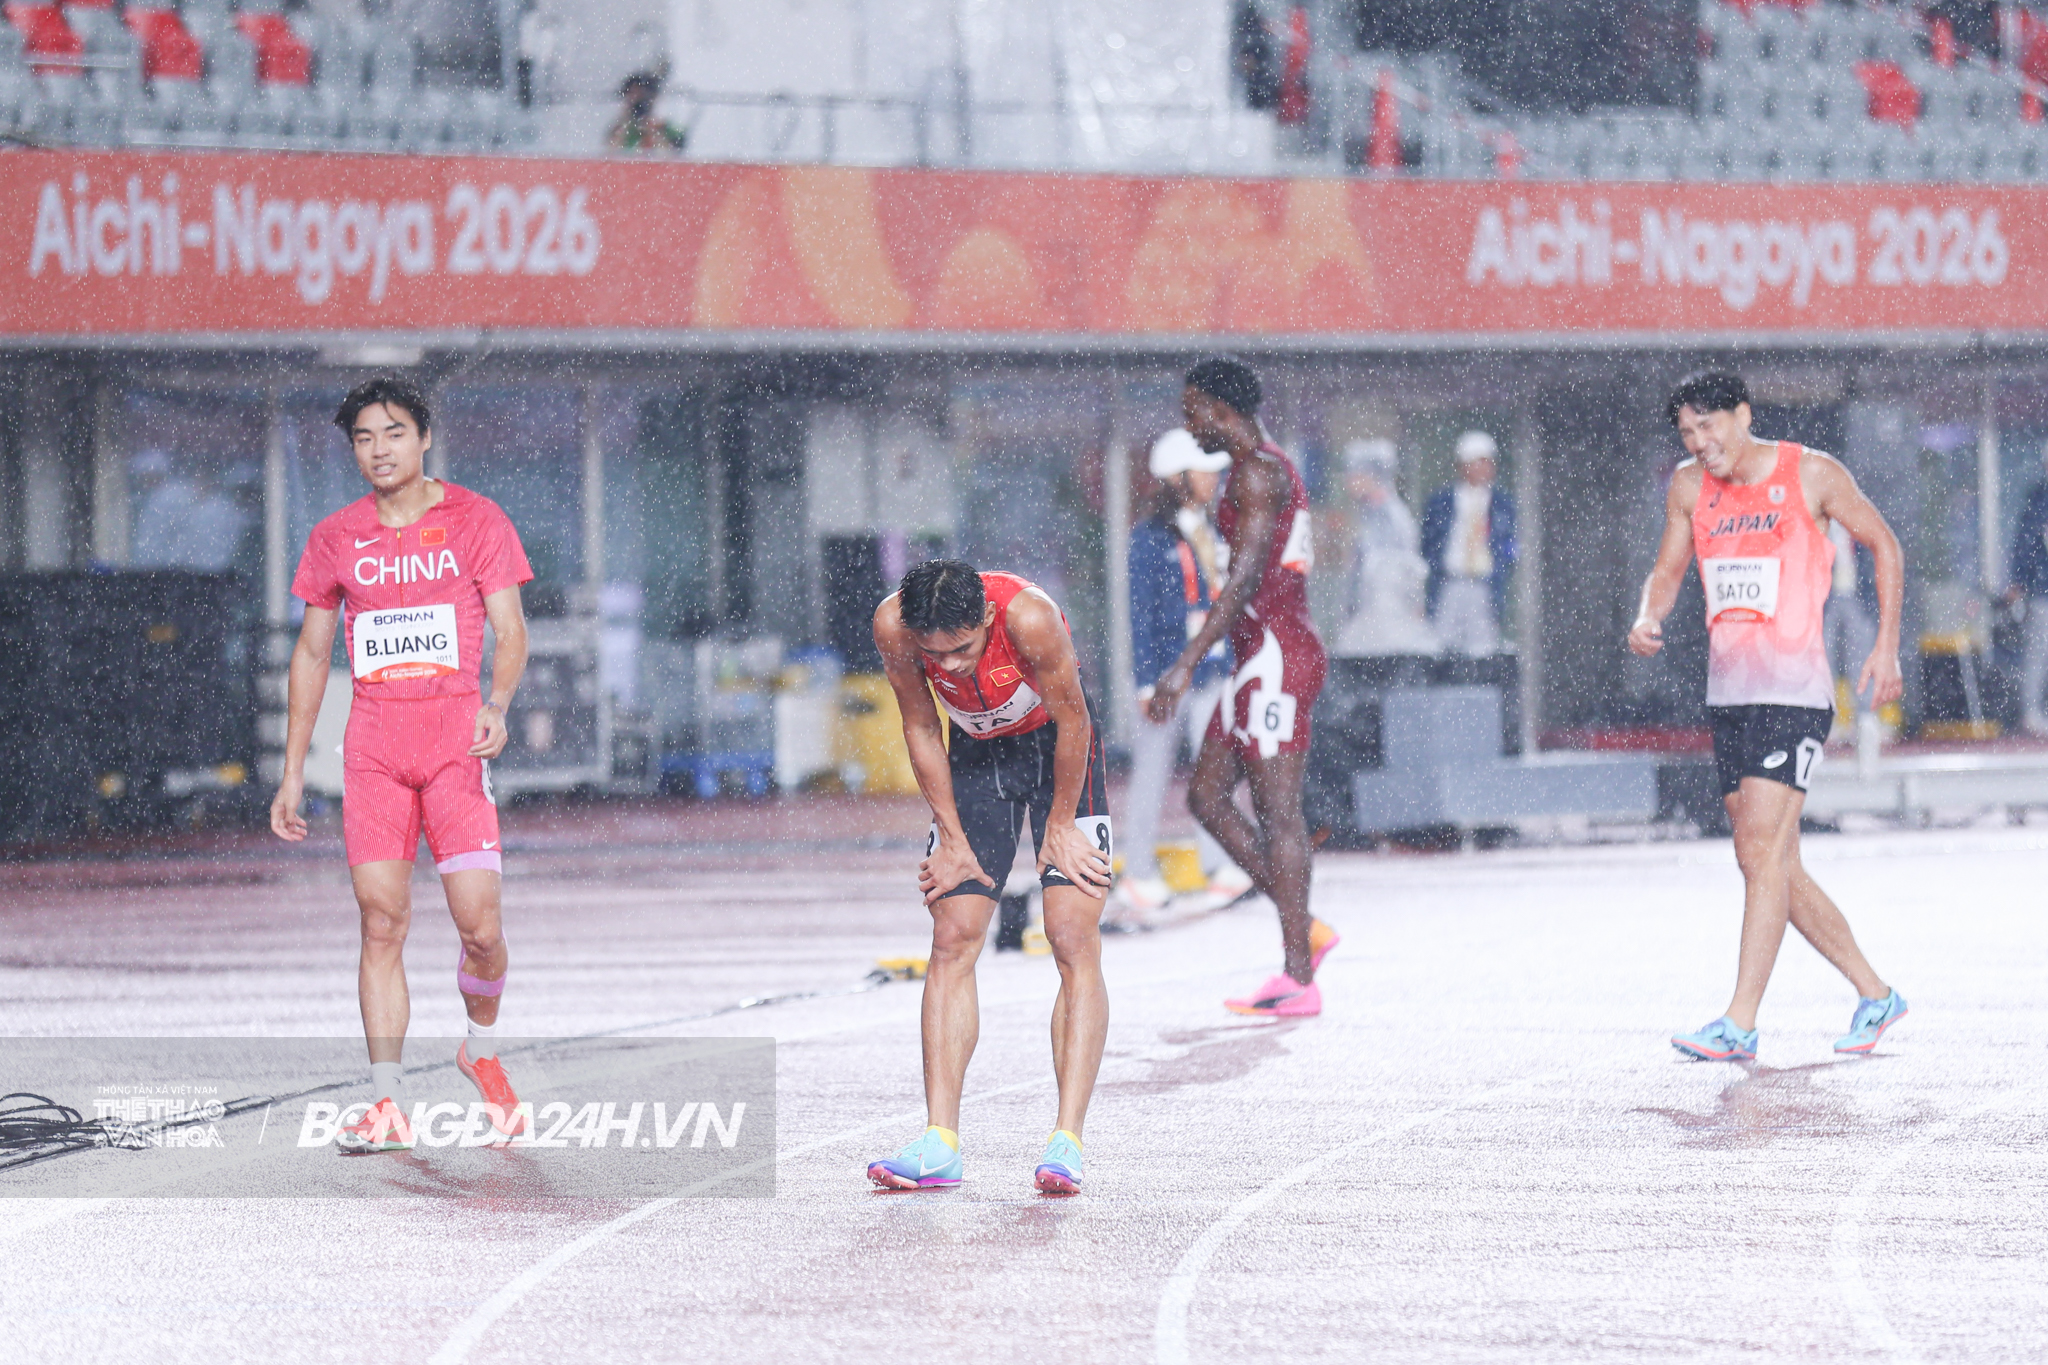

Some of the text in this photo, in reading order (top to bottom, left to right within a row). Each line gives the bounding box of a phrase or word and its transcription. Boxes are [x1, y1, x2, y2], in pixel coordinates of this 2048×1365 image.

[29, 170, 600, 304] Aichi-Nagoya 2026
[1466, 198, 2009, 311] Aichi-Nagoya 2026
[1710, 512, 1779, 537] JAPAN
[354, 549, 460, 586] CHINA
[1716, 582, 1760, 602] SATO
[373, 610, 434, 626] BORNAN
[366, 633, 448, 657] B.LIANG
[436, 655, 452, 663] 1011
[969, 717, 1013, 731] TA
[1264, 702, 1281, 731] 6
[1805, 746, 1815, 780] 7
